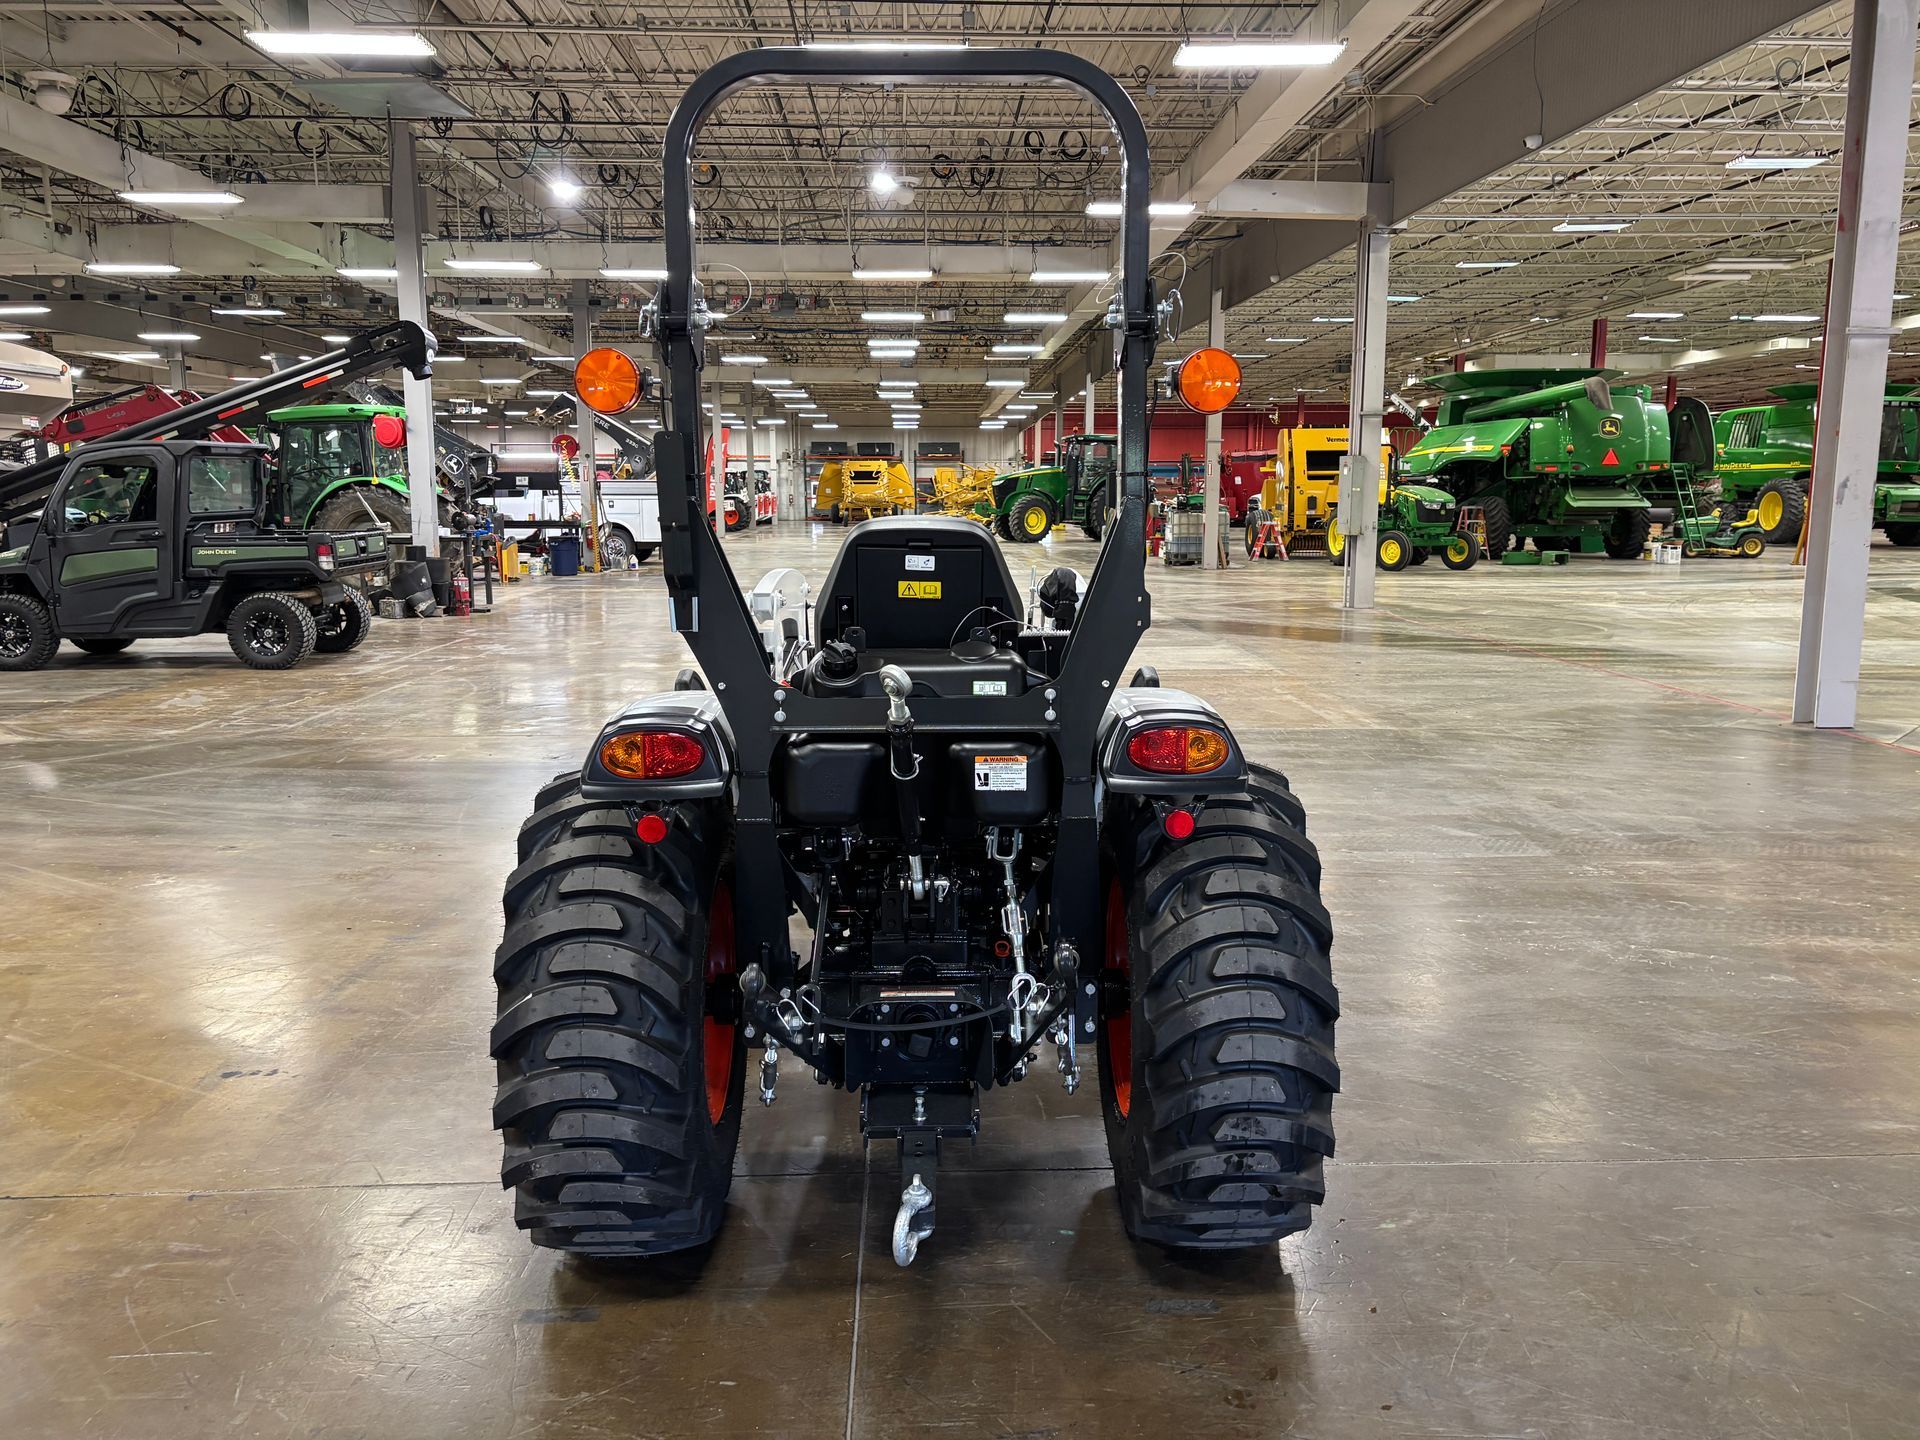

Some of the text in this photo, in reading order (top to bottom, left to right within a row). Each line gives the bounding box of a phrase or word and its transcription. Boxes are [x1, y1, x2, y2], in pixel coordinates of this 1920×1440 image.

[510, 296, 520, 304] 93
[547, 297, 557, 305] 95
[620, 297, 630, 305] 99
